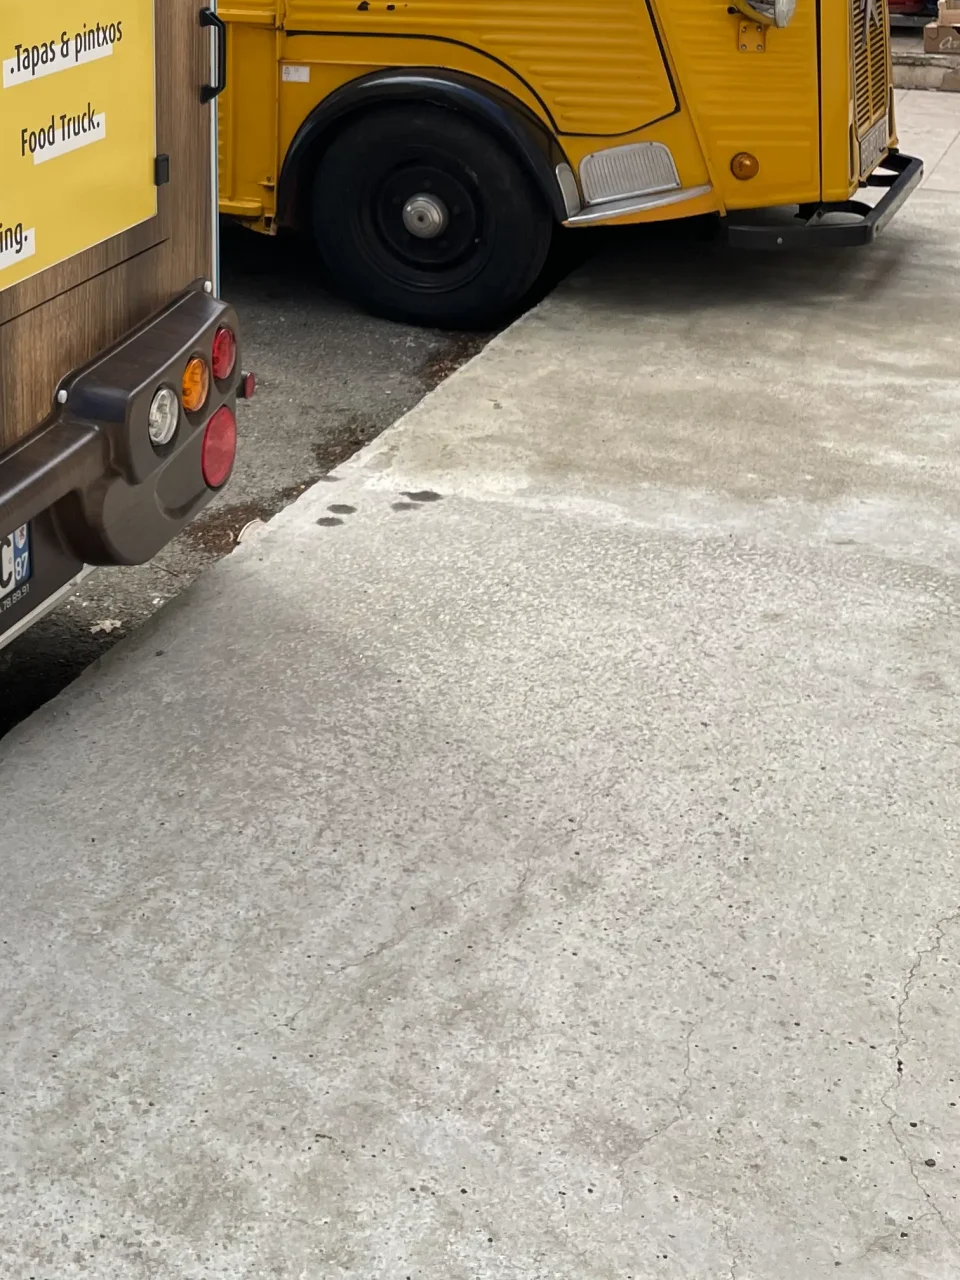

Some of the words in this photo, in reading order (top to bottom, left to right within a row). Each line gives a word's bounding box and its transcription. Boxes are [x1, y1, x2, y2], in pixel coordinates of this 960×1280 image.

[60, 31, 71, 59] &
[74, 20, 123, 57] pintxos
[21, 120, 56, 157] Food
[60, 102, 101, 143] Truck.
[14, 551, 29, 581] 87
